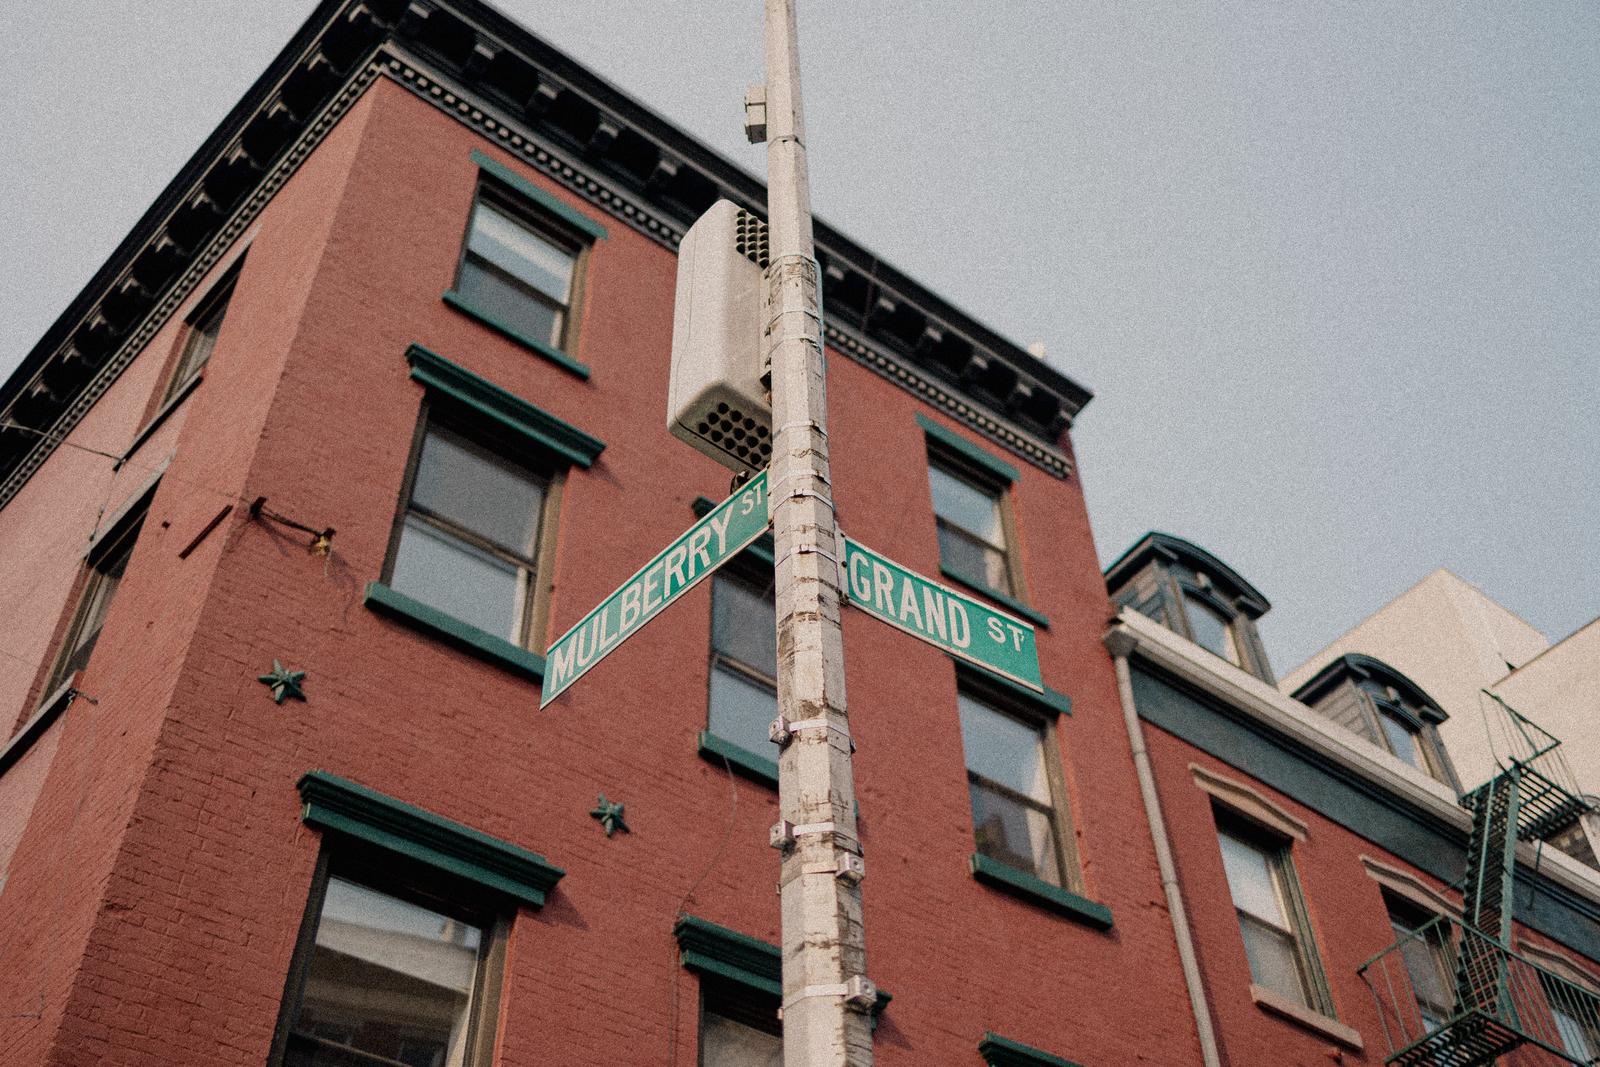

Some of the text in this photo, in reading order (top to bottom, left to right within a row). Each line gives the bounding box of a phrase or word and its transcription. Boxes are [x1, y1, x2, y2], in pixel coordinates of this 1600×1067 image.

[550, 479, 765, 693] MULBERRY ST
[850, 551, 971, 648] GRAND
